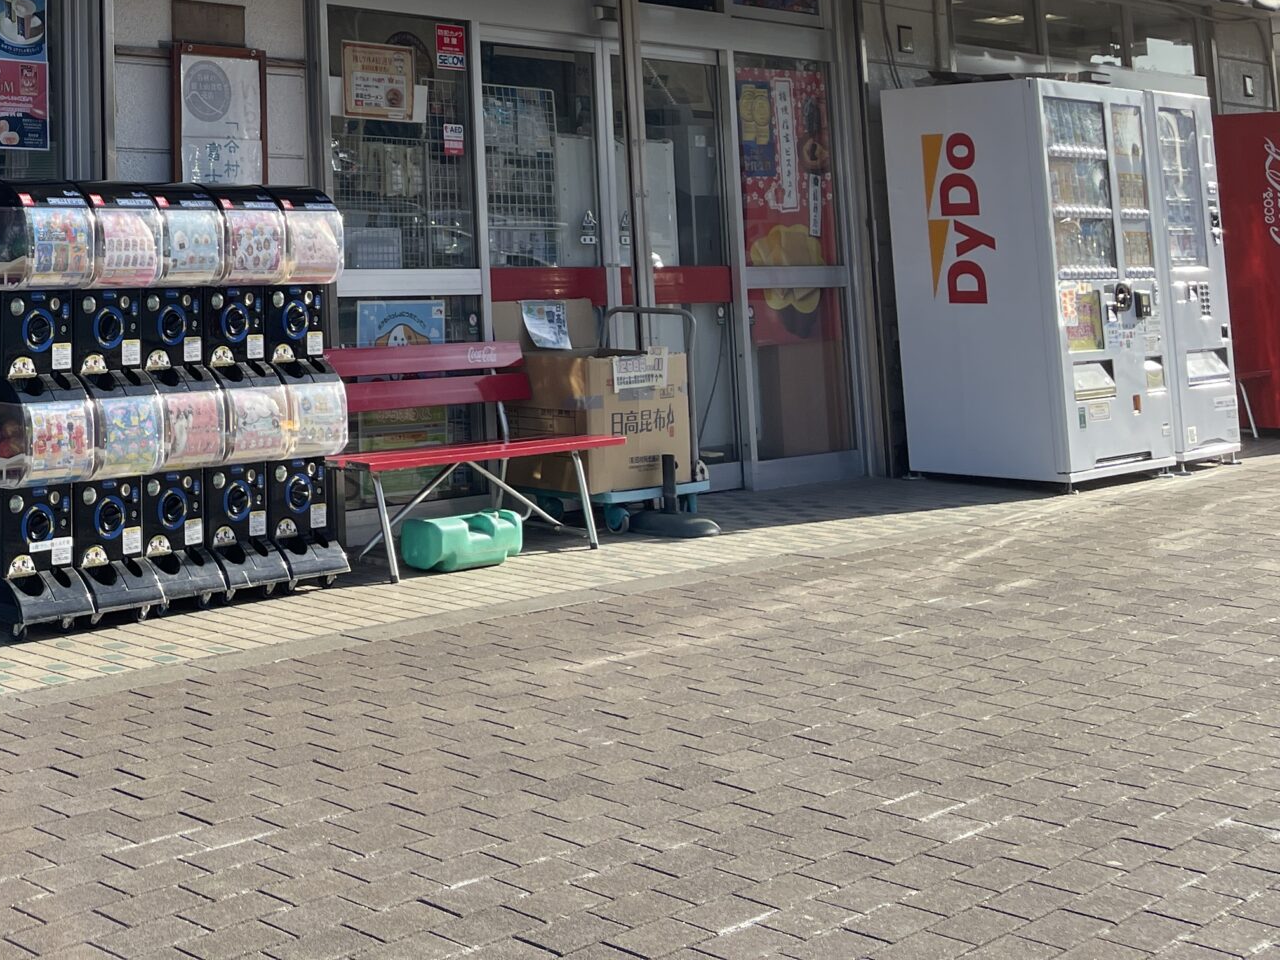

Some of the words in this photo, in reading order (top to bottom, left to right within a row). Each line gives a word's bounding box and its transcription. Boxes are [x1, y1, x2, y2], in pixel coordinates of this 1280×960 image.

[439, 54, 464, 66] SECOM
[450, 126, 463, 134] AED
[939, 131, 997, 305] DyDo
[611, 408, 666, 436] 日高昆布
